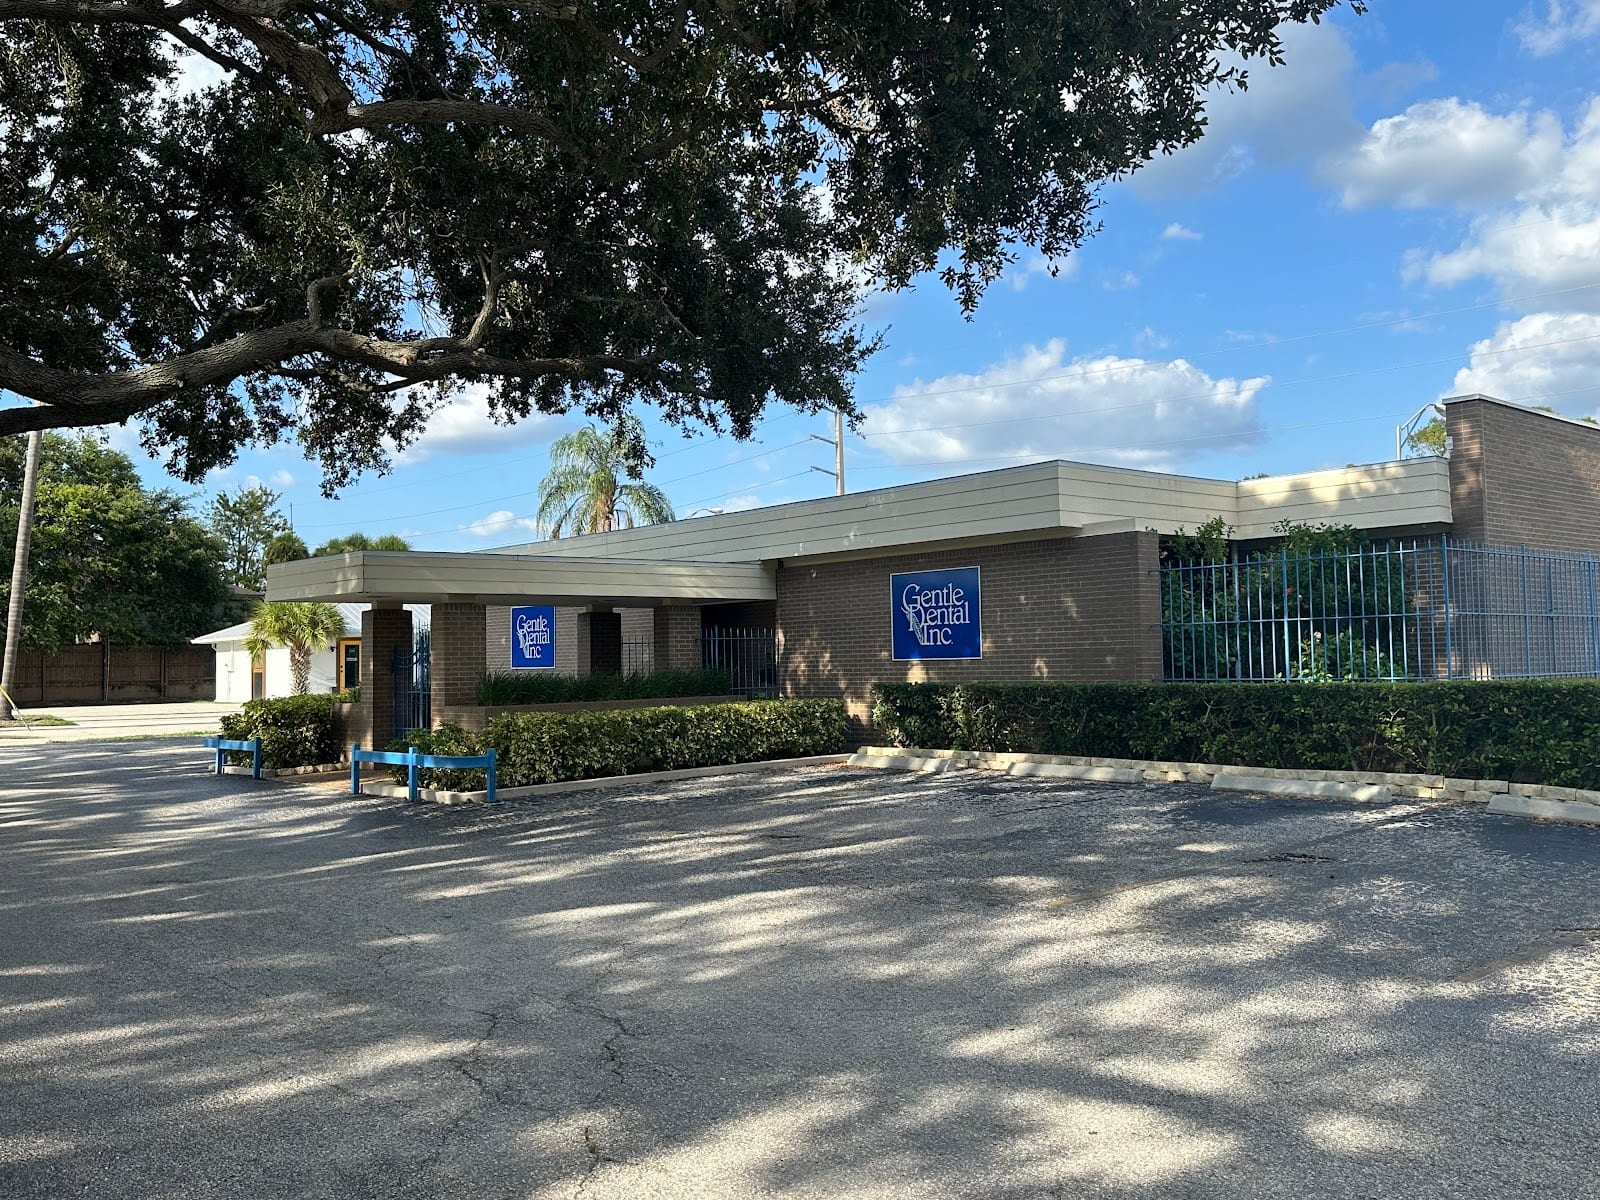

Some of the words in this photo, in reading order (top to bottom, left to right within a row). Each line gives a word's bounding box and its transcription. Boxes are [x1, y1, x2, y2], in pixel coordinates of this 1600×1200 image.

[903, 583, 964, 612] Gentle
[517, 614, 547, 635] Gentle
[908, 601, 970, 631] Dental
[519, 628, 549, 648] Dental
[920, 623, 954, 646] Inc.
